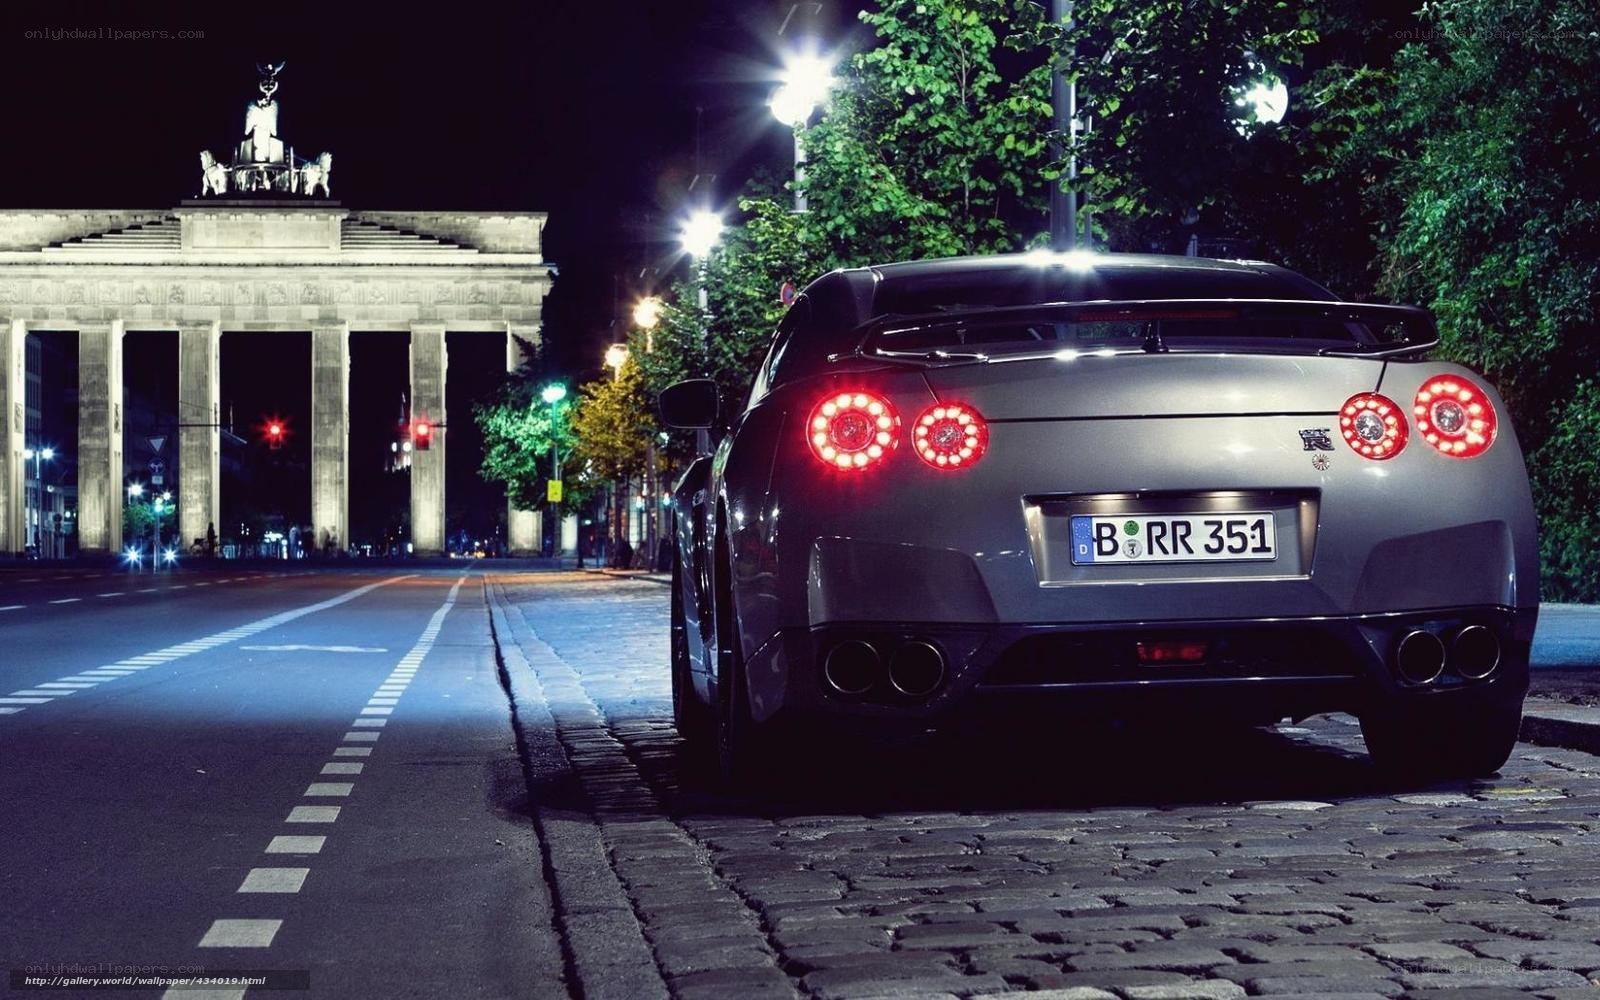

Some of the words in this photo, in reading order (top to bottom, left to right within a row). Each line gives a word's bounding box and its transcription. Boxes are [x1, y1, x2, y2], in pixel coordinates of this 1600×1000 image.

[1079, 544, 1088, 555] D
[1096, 523, 1119, 556] B
[1147, 520, 1194, 555] RR
[1204, 519, 1271, 554] 351
